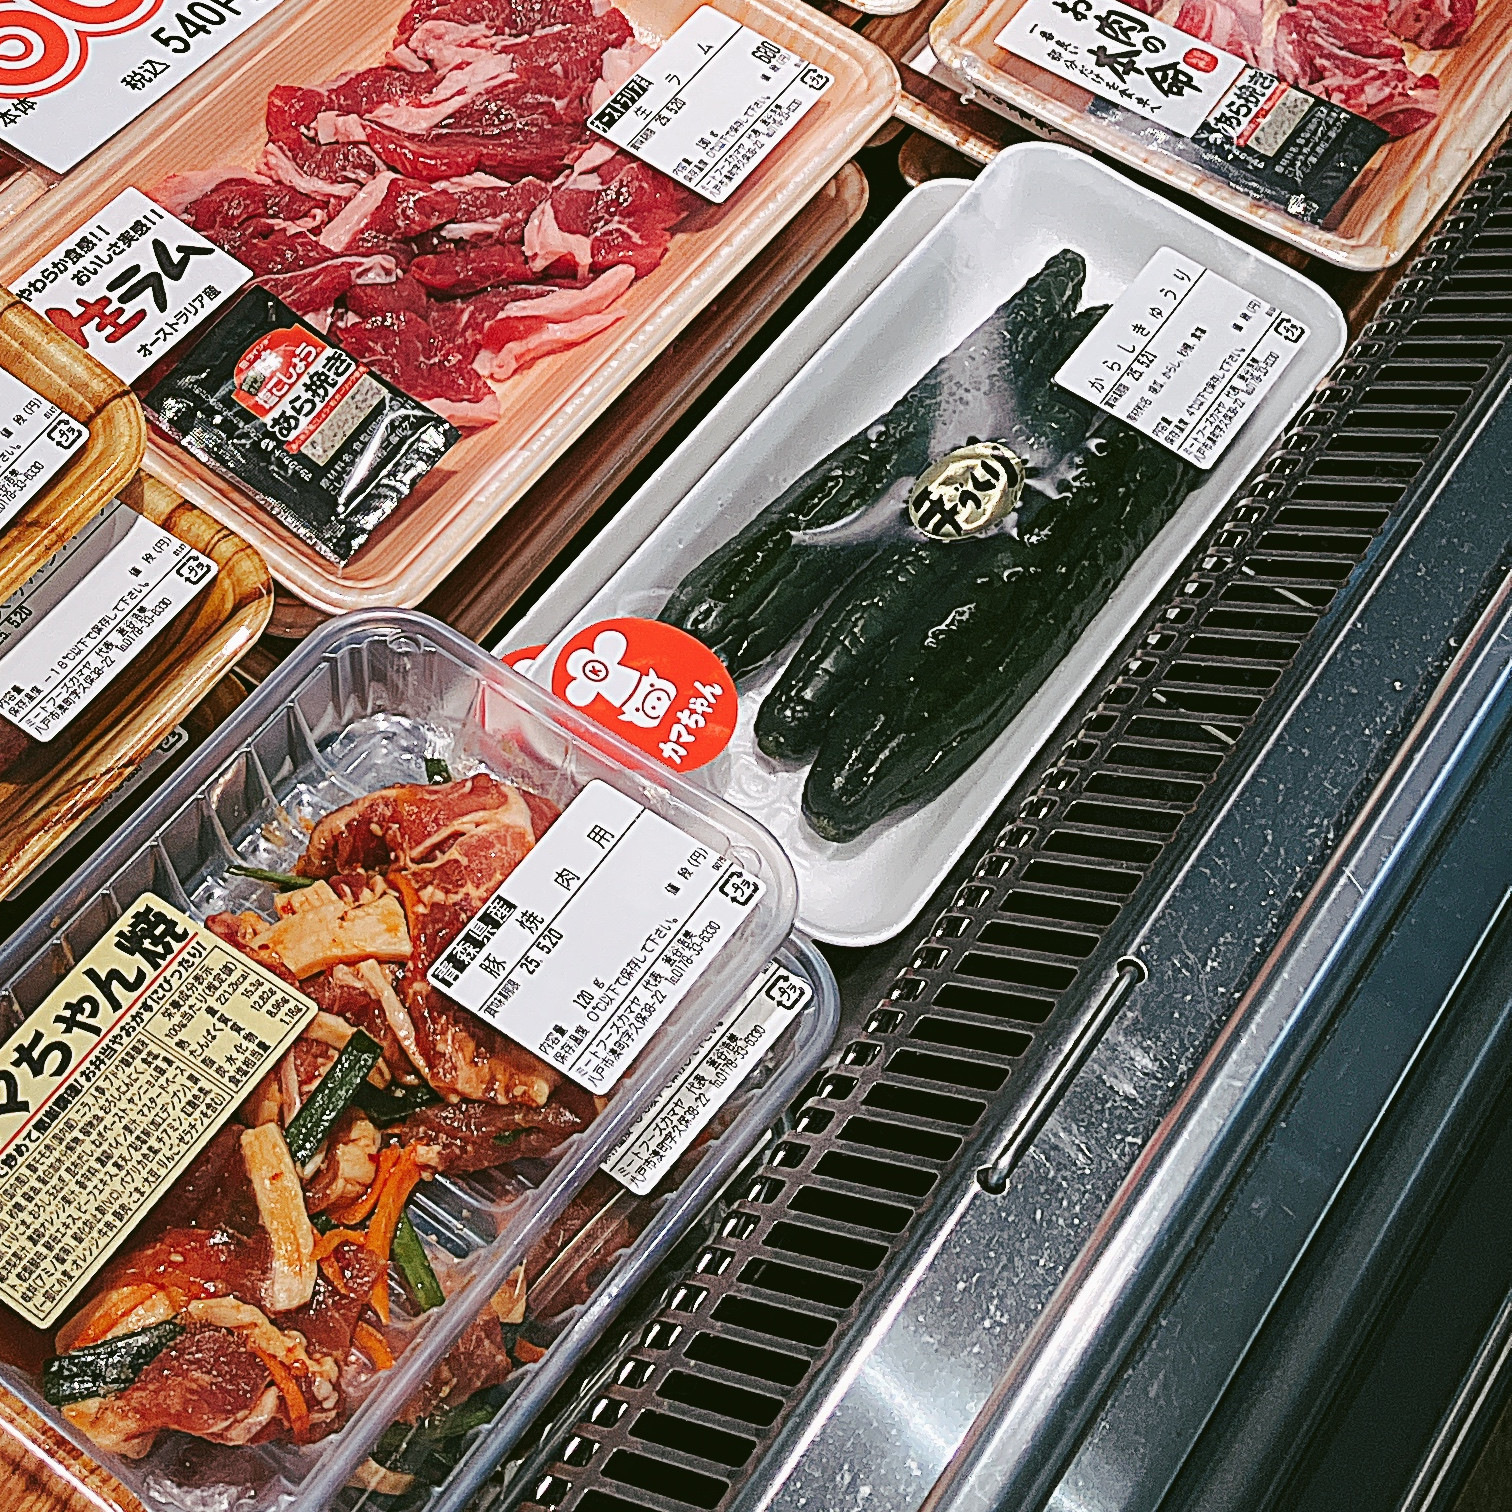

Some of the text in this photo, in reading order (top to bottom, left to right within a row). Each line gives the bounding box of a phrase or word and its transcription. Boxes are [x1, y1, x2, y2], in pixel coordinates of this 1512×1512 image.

[120, 58, 172, 94] 税込
[633, 42, 715, 122] 生ラム
[752, 39, 781, 65] 680
[1086, 41, 1204, 99] 本命
[1211, 69, 1279, 144] あら挽き
[44, 236, 216, 350] 生ラム
[135, 284, 223, 360] オーストラリア産
[1087, 268, 1193, 395] からしきゅうり
[266, 350, 357, 446] あら挽き
[658, 680, 724, 766] カマちゃん
[479, 822, 616, 980] 豚焼肉用
[433, 896, 517, 988] 青森県産
[540, 927, 565, 956] 520
[160, 963, 215, 1020] 栄養成分表示
[537, 1023, 569, 1056] 内容量
